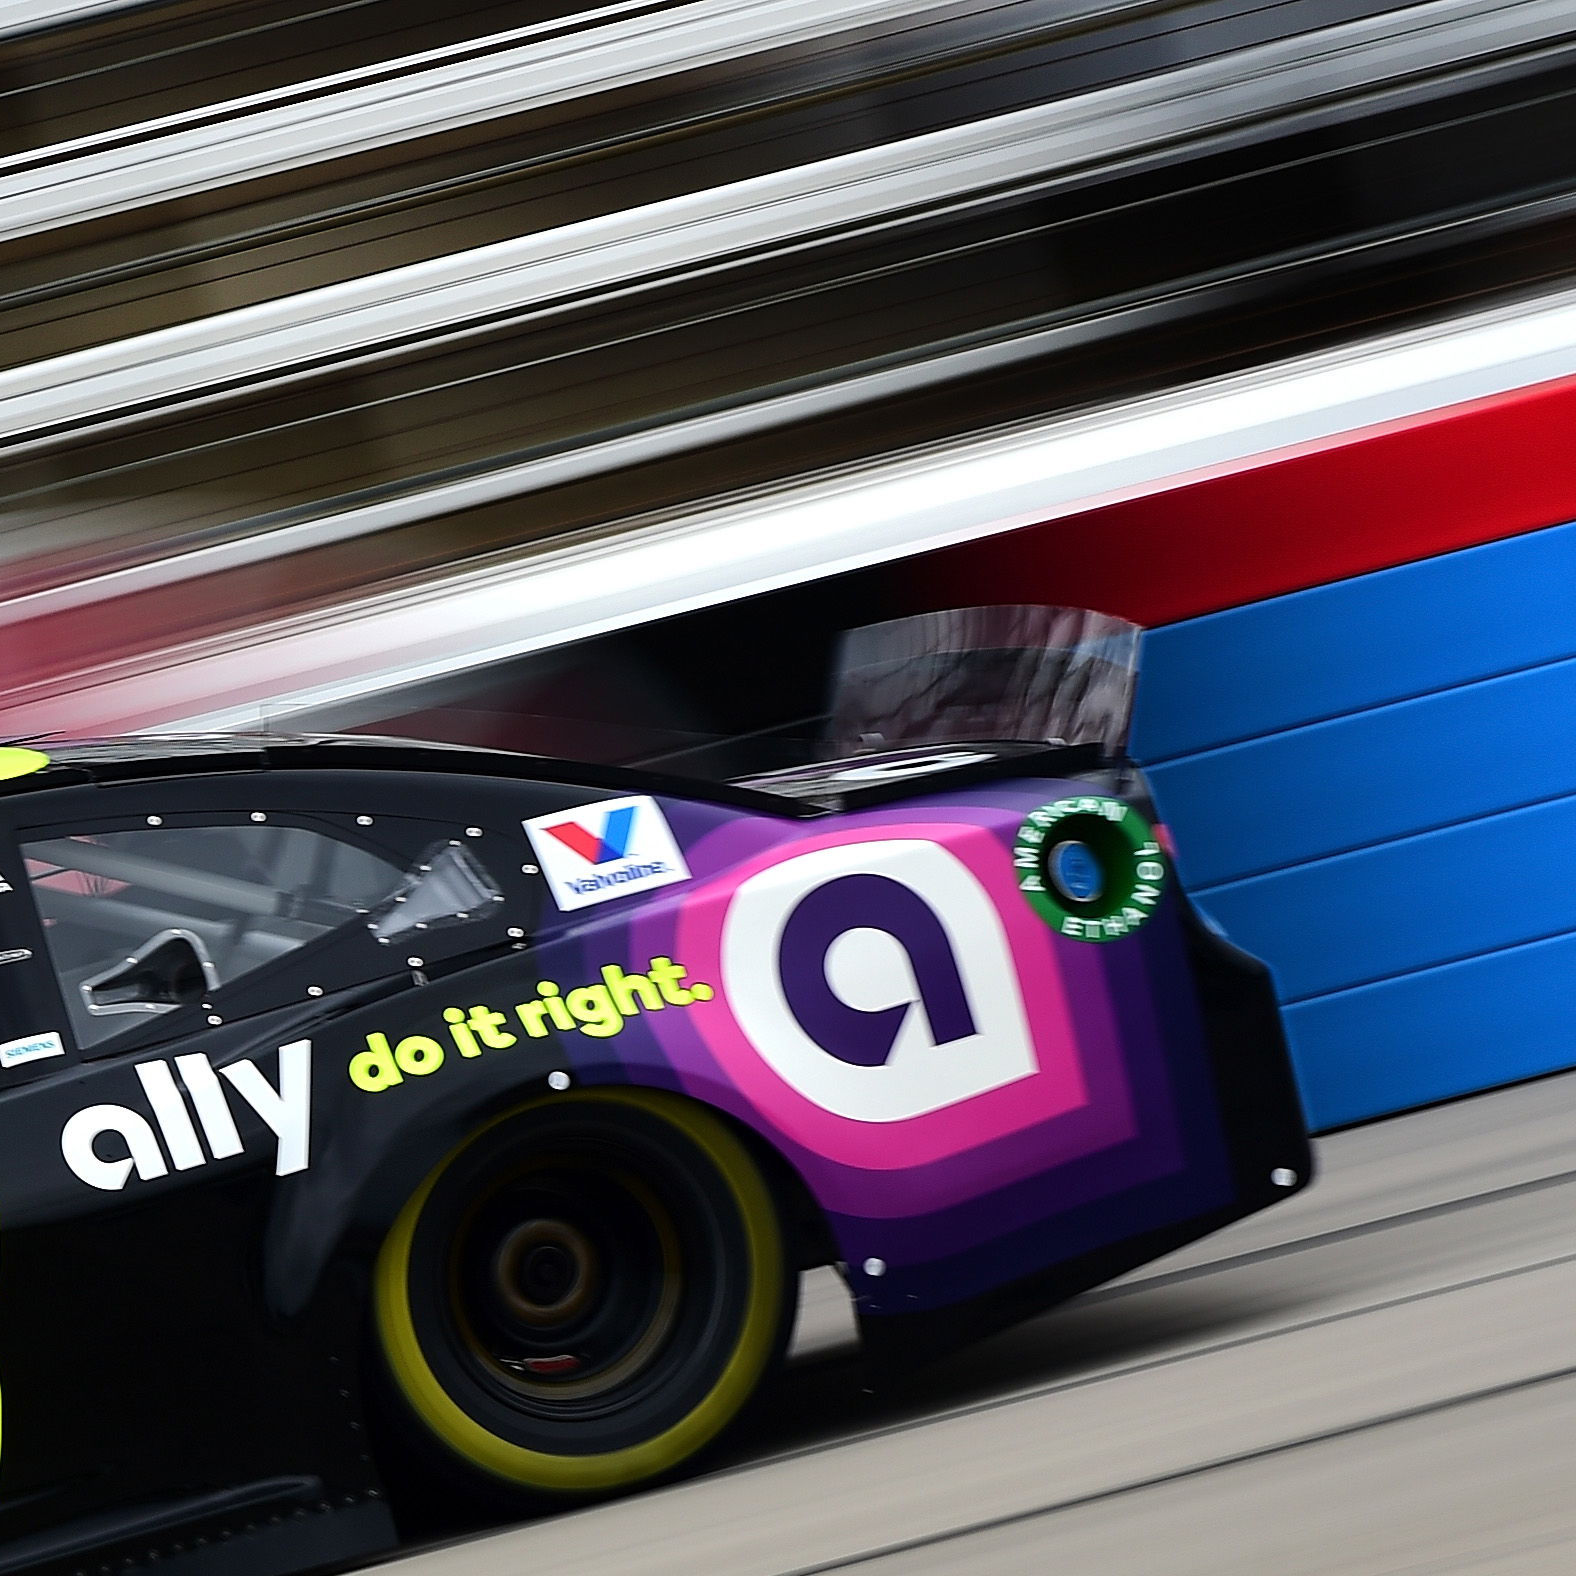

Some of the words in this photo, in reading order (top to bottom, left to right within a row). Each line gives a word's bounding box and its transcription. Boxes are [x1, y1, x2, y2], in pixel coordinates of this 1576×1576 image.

[564, 861, 667, 894] Valvoline
[1013, 799, 1128, 892] AMERICAN
[1061, 842, 1164, 938] ETHANOL
[349, 1031, 445, 1092] do
[443, 1006, 517, 1058] it
[515, 956, 714, 1038] right.
[61, 1040, 311, 1191] ally
